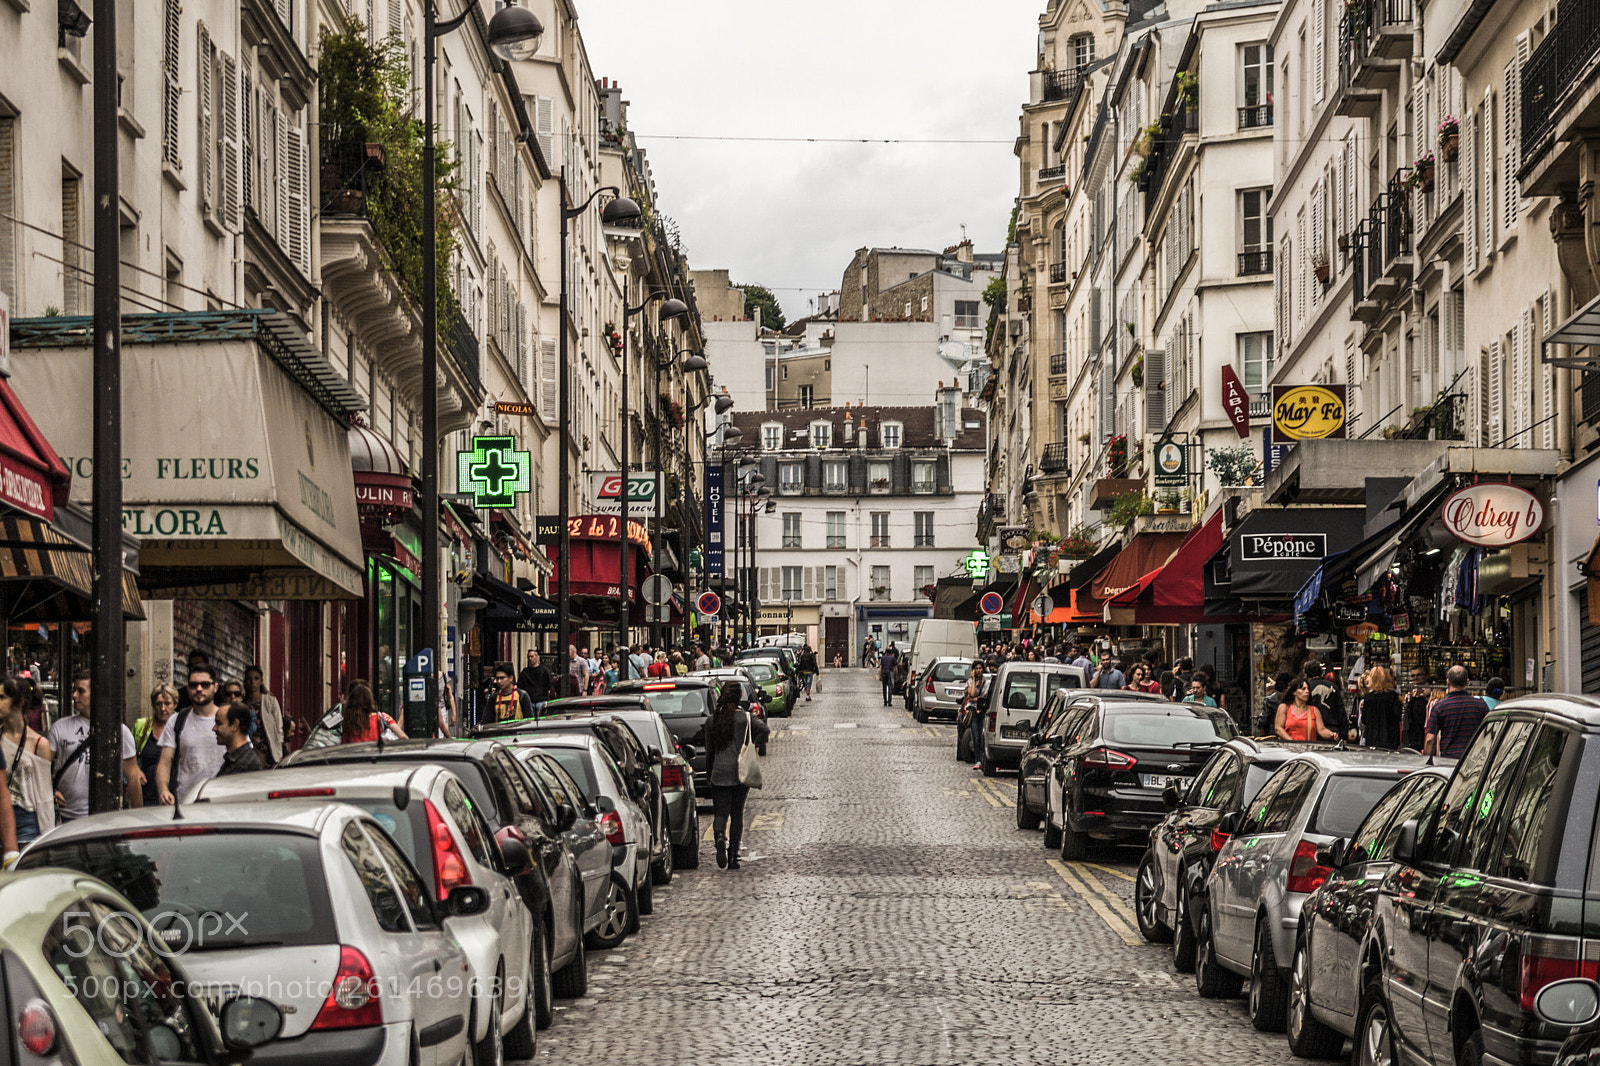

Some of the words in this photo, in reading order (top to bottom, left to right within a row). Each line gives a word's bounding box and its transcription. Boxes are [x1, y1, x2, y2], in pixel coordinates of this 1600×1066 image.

[497, 404, 533, 414] NICOLAS
[1226, 380, 1245, 423] TABAC
[1276, 402, 1317, 430] May
[1321, 402, 1343, 421] Fa
[156, 457, 260, 480] FLEURS
[356, 487, 394, 502] ULIN
[709, 486, 721, 524] HOTEL
[608, 516, 618, 537] 2
[1447, 497, 1521, 540] Odrey
[1525, 499, 1537, 528] b
[538, 525, 560, 535] PAU
[1252, 536, 1316, 557] Pépone
[417, 655, 429, 672] P
